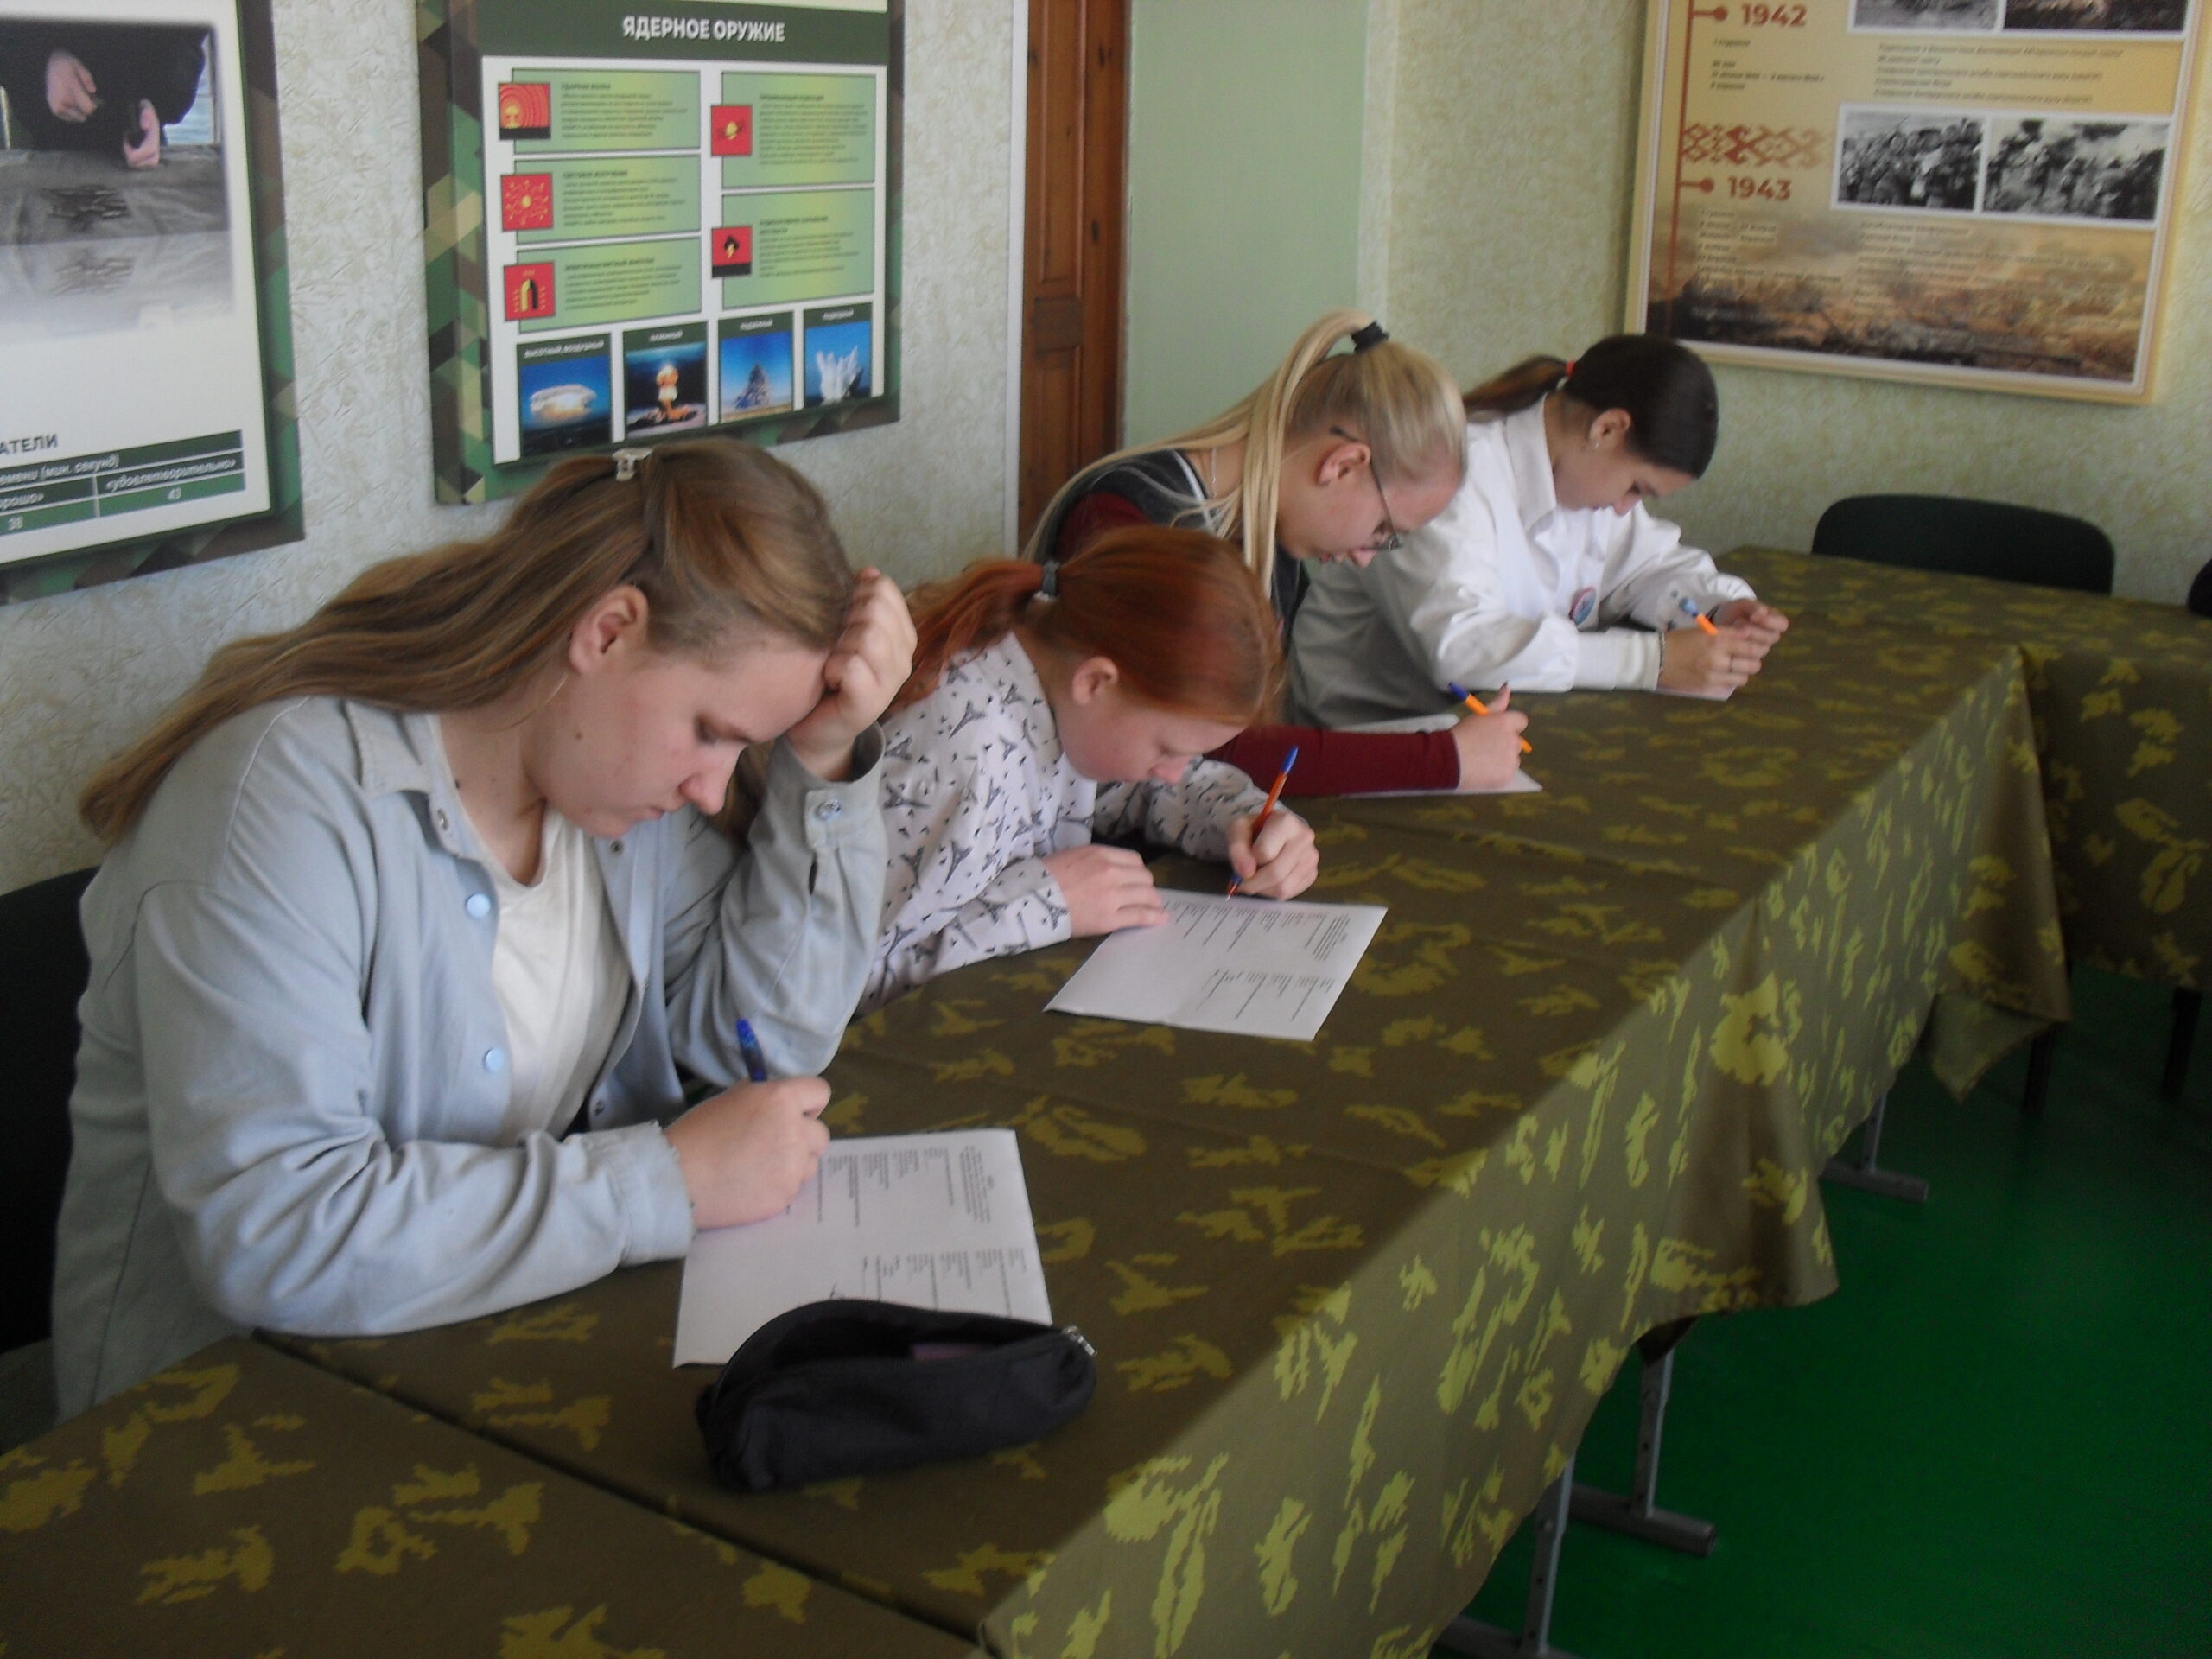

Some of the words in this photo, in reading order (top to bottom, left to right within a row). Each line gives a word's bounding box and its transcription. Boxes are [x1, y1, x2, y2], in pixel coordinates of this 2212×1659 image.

[1741, 3, 1808, 27] 1942
[623, 16, 710, 41] ЯДЕРНОЕ
[713, 20, 785, 42] ОРУЖИЕ
[1729, 175, 1792, 201] 1943
[167, 487, 181, 501] 43
